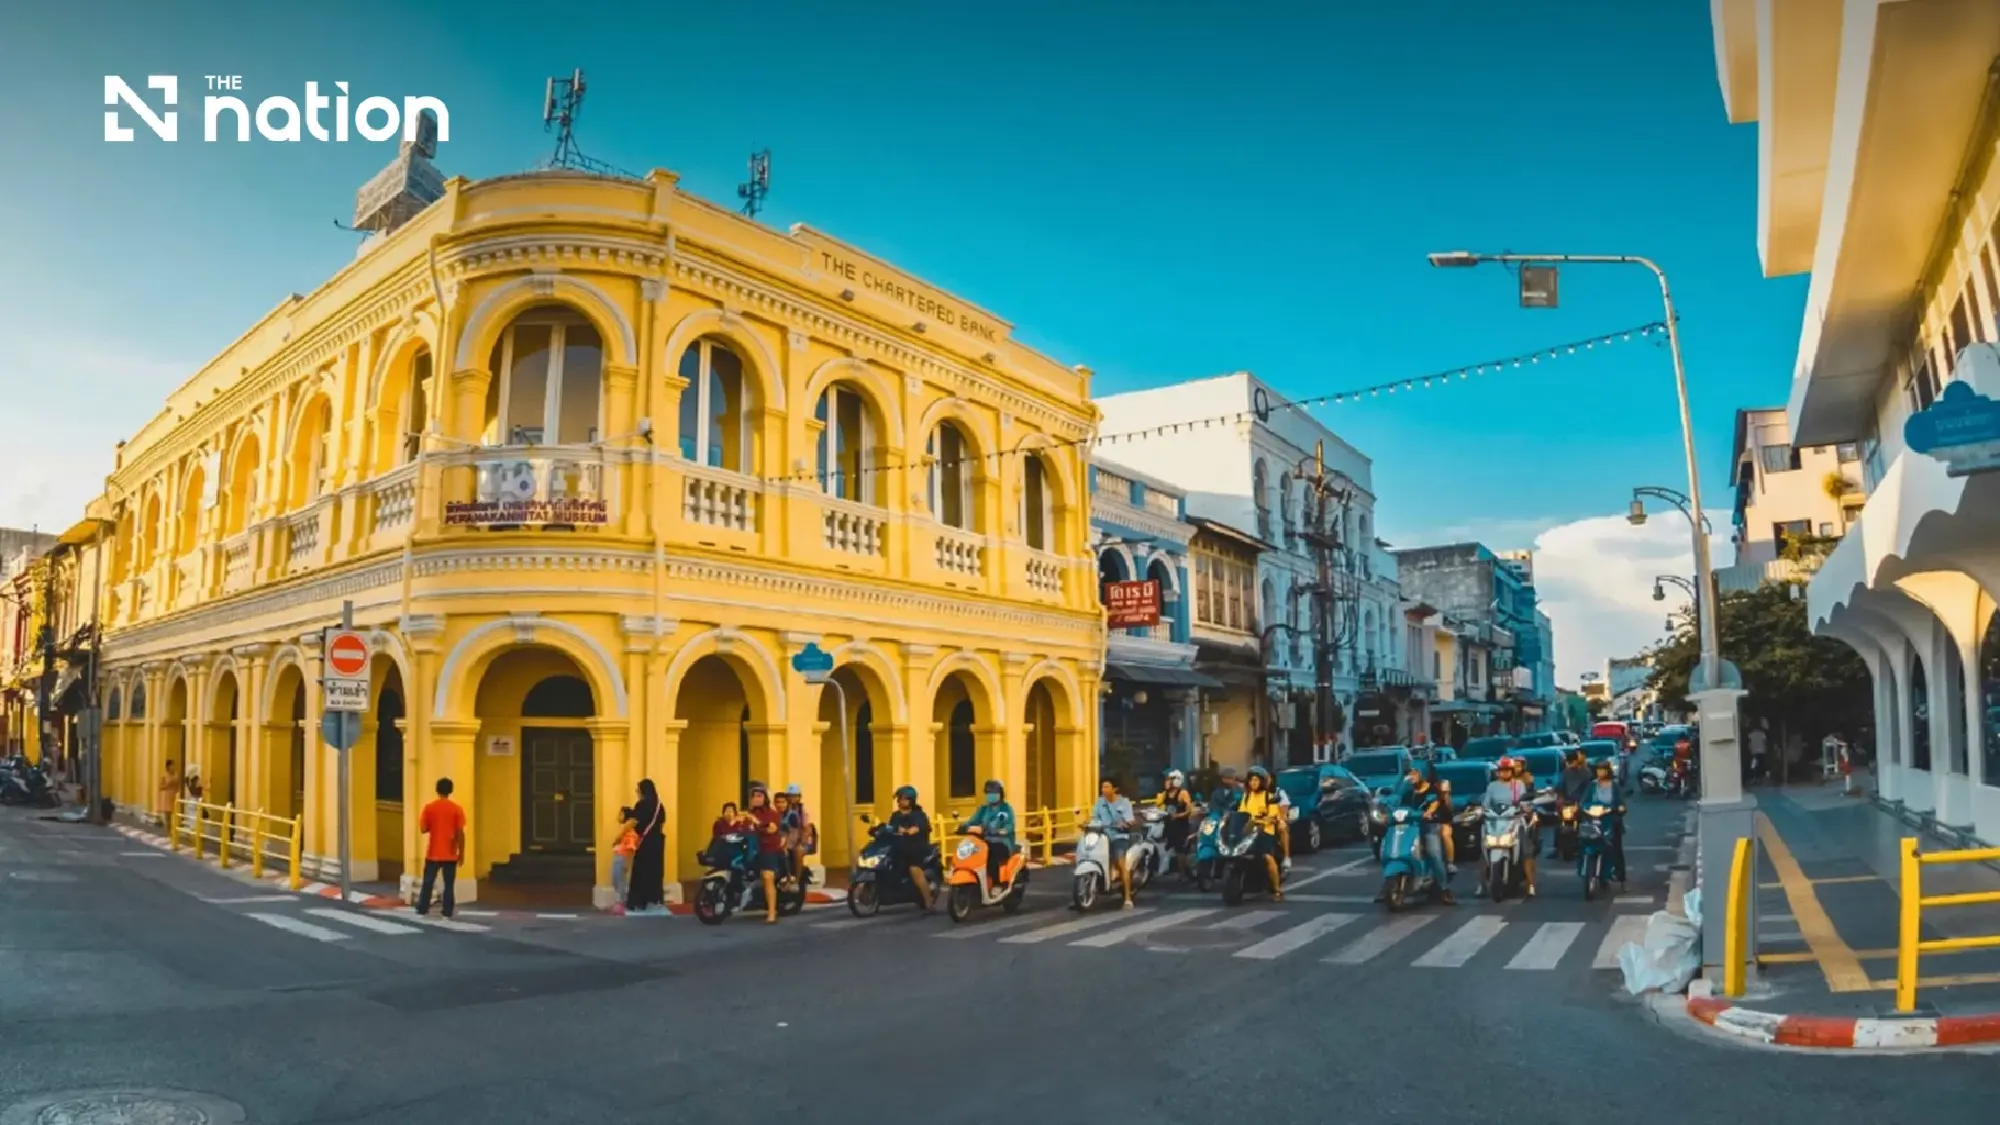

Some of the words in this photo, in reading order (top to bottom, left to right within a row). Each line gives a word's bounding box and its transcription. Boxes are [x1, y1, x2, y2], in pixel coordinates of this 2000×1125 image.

[821, 252, 856, 281] THE
[862, 271, 955, 325] CHARTERED
[959, 314, 997, 343] BANK
[553, 510, 608, 523] MUSEUM
